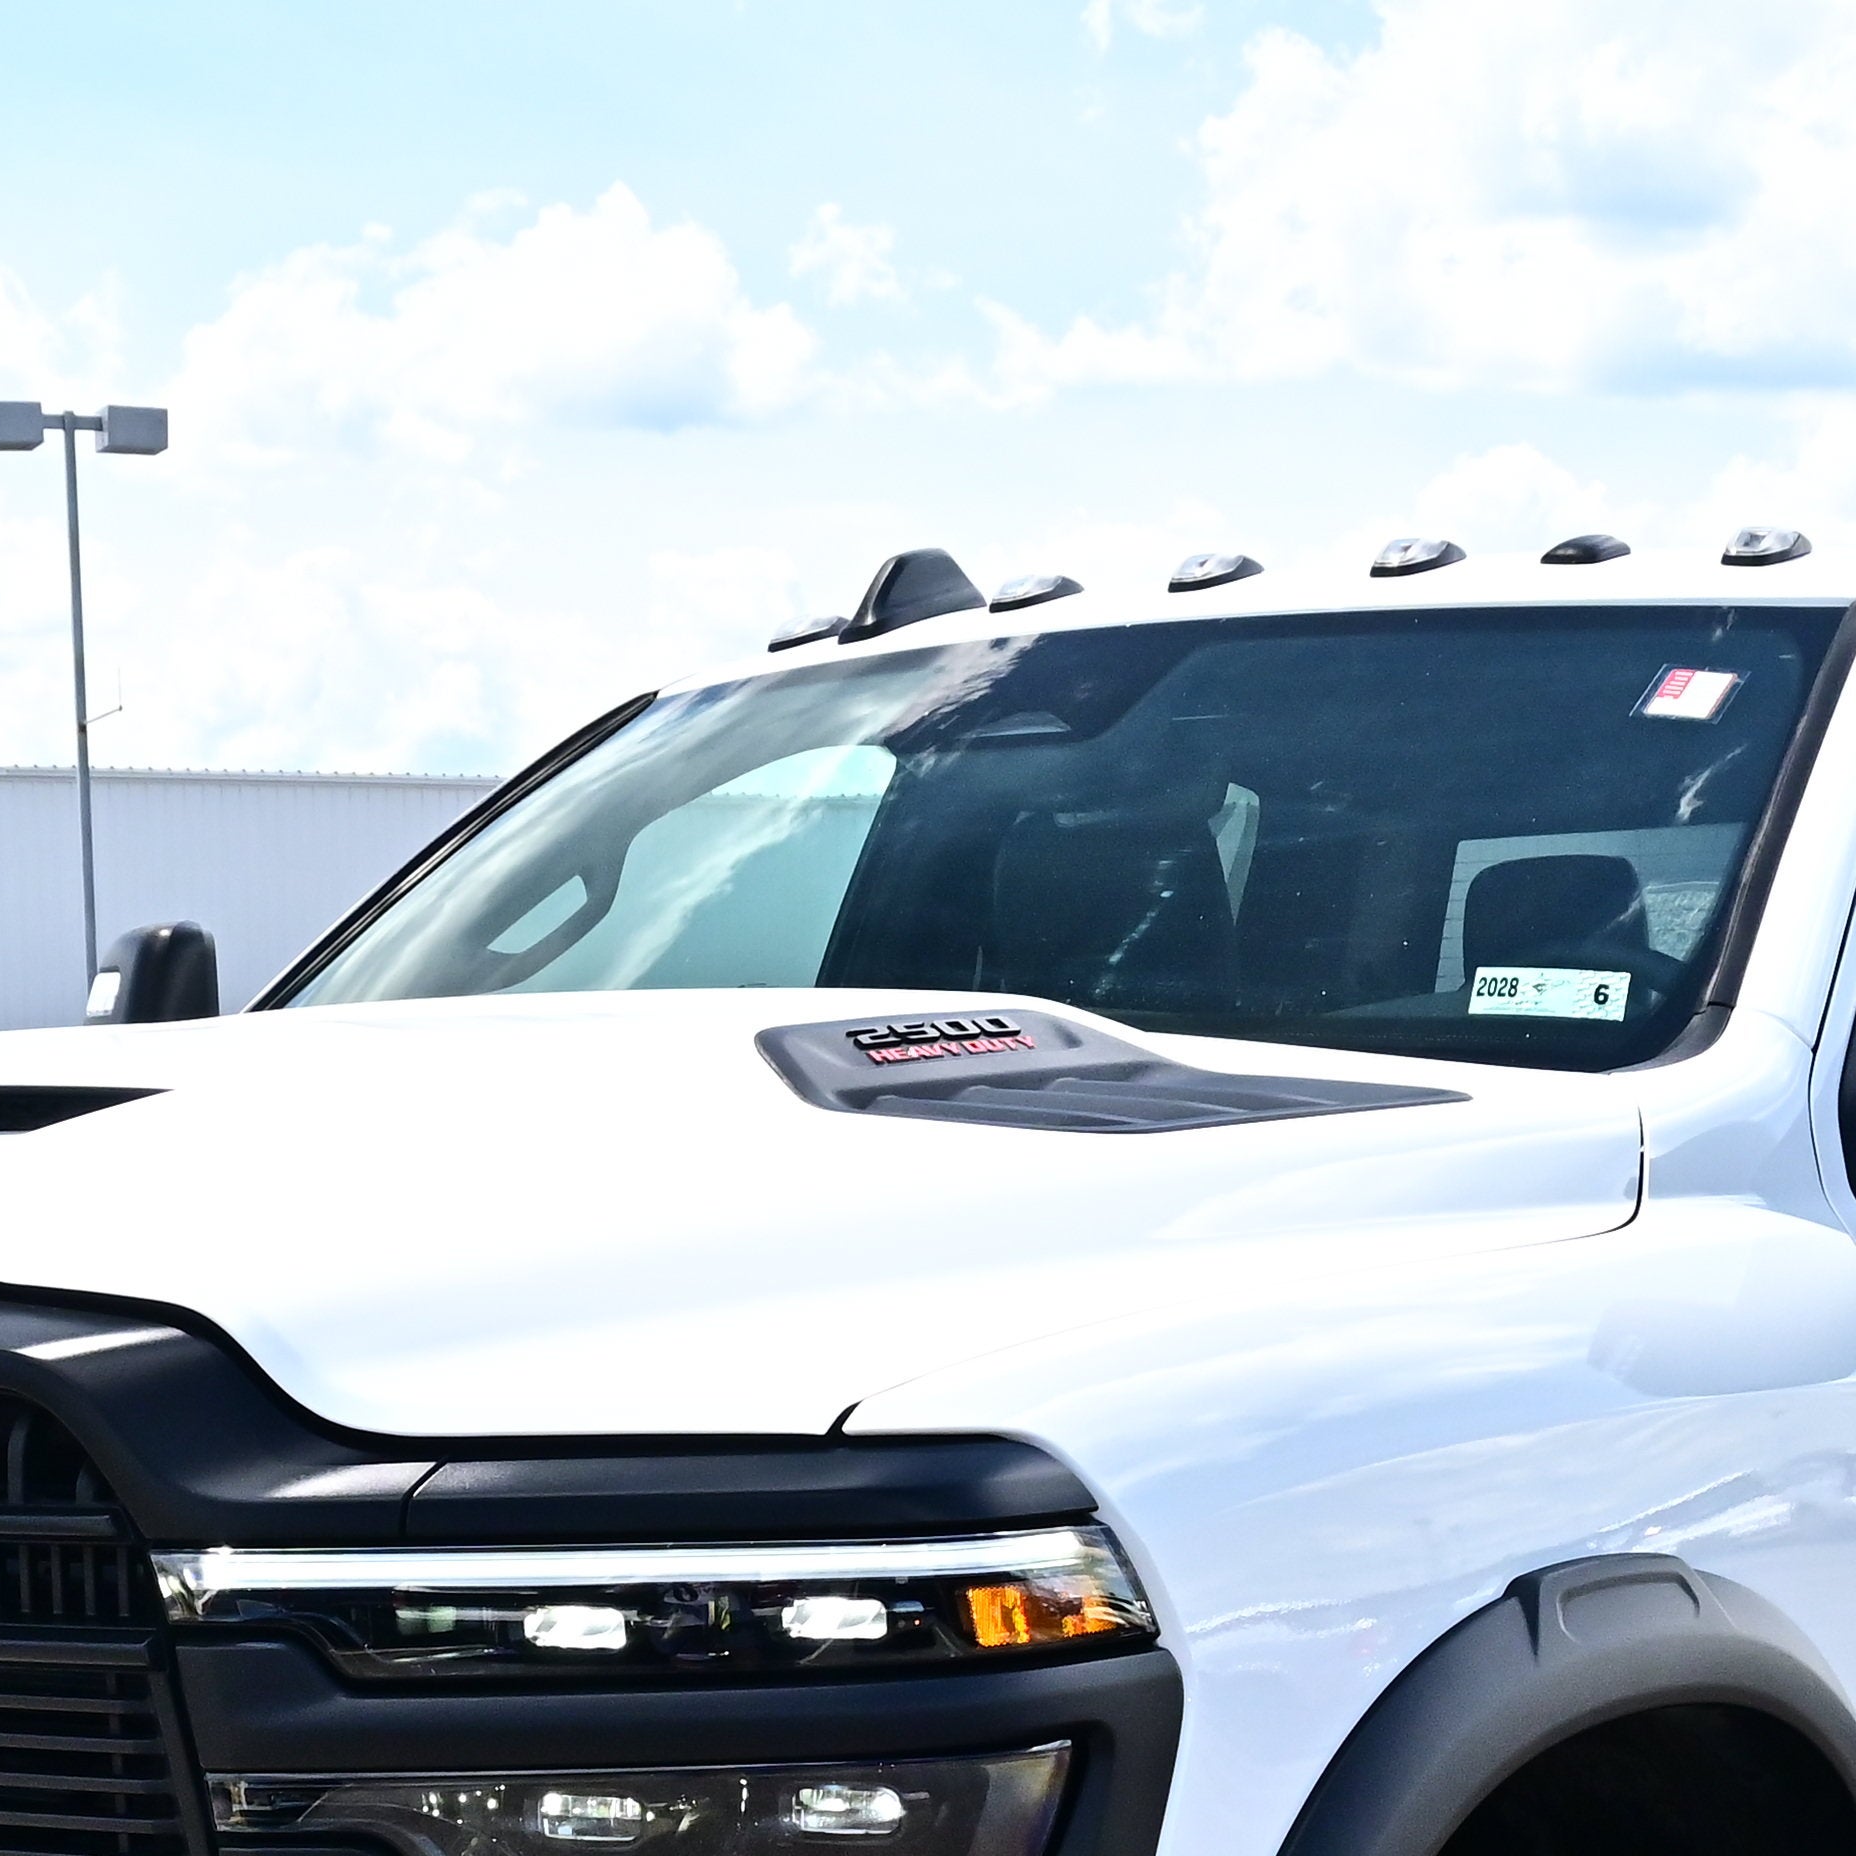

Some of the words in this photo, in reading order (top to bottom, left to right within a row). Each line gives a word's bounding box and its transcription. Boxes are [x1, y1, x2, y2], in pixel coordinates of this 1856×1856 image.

[1476, 977, 1520, 998] 2028
[1594, 983, 1610, 1005] 6
[846, 1015, 1022, 1051] 2500
[865, 1041, 962, 1065] HEAVY
[961, 1035, 1036, 1055] DUTY
